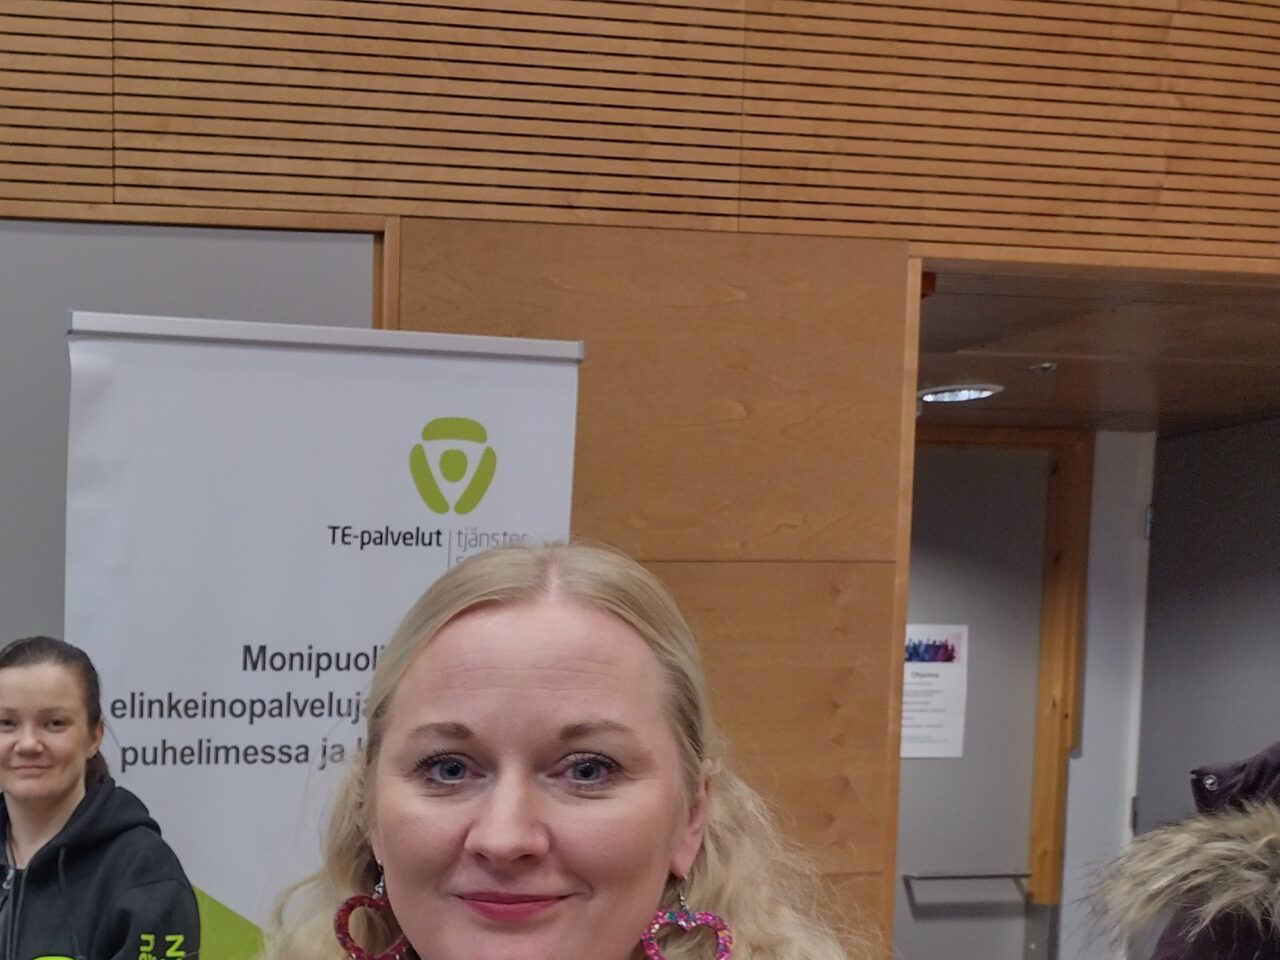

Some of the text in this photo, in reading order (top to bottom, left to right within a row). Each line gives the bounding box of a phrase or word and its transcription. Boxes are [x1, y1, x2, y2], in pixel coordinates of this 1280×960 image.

[327, 525, 443, 550] TE-palvelut
[241, 644, 386, 678] Monipuol
[110, 690, 368, 725] elinkeinopalveluj
[120, 736, 310, 773] puhelimessa
